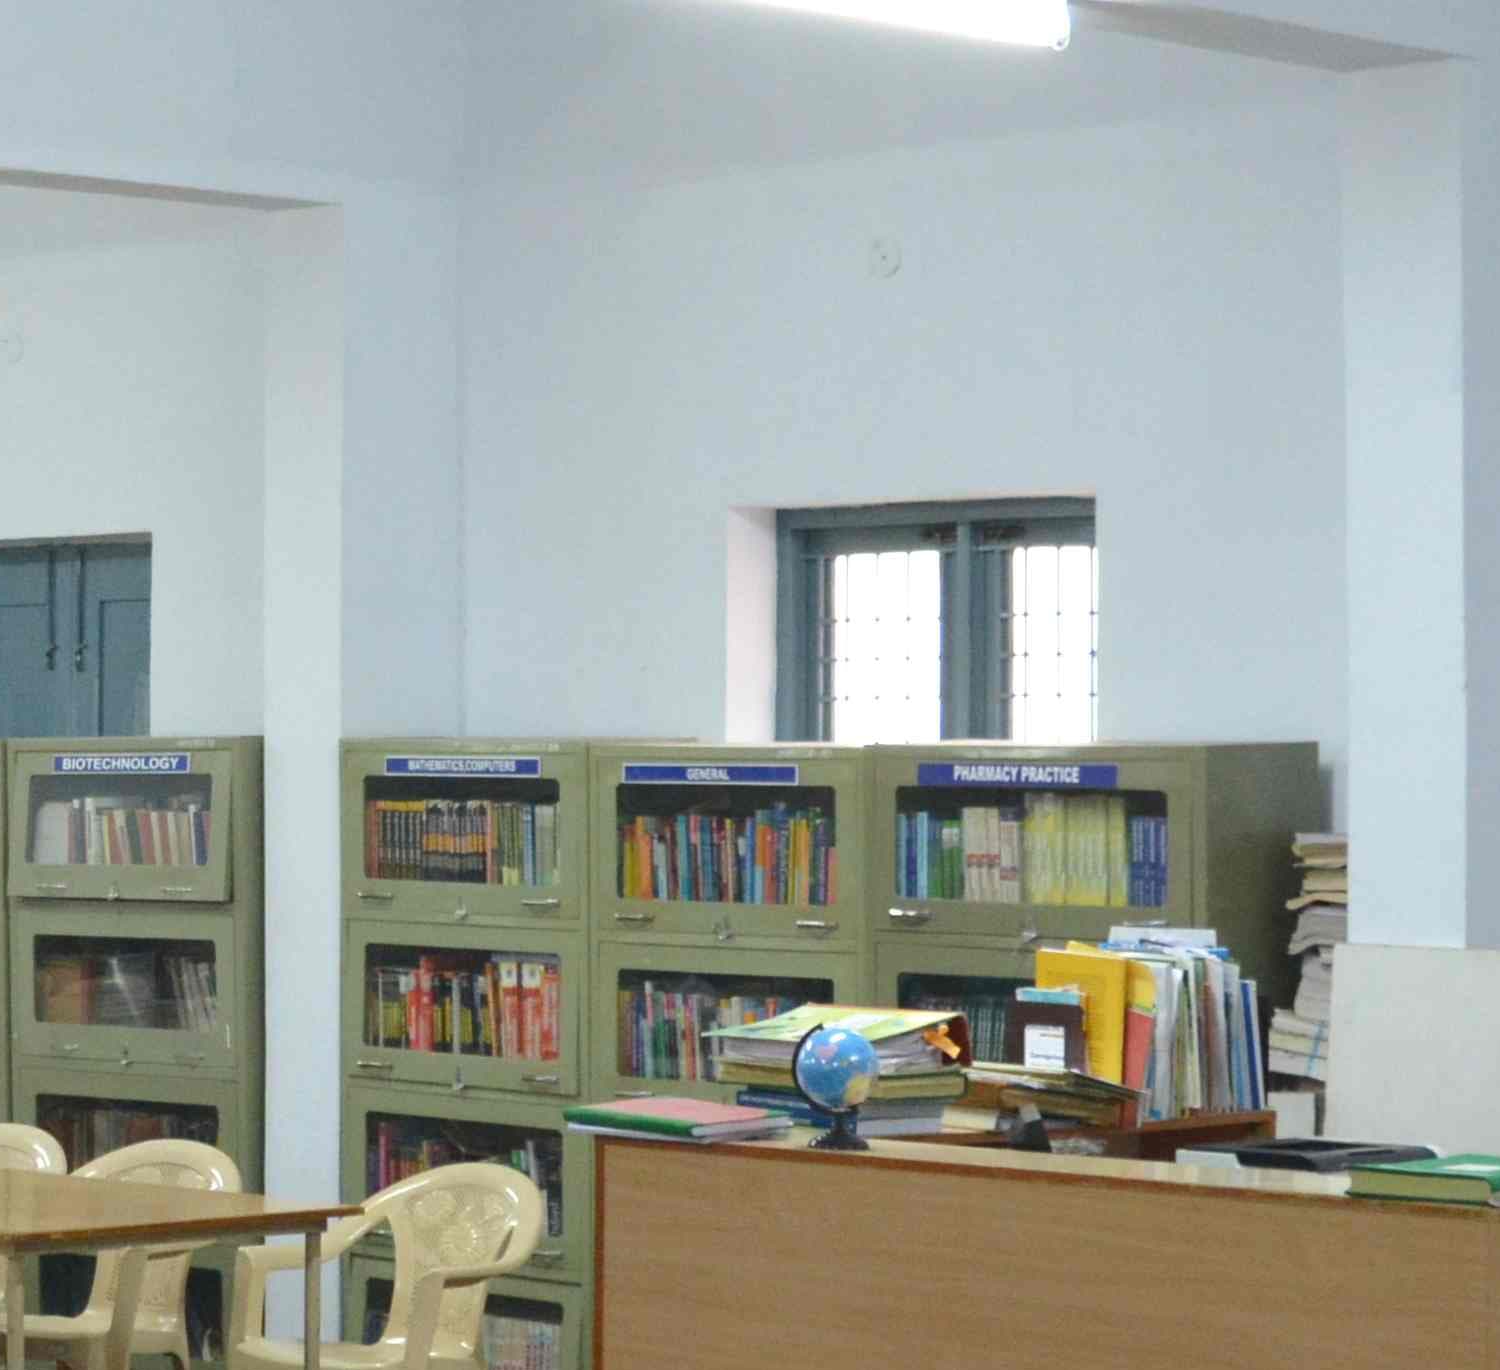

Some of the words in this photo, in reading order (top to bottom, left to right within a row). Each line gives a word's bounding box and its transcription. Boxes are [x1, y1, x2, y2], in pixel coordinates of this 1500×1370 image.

[61, 757, 180, 771] BIOTECHNOLOGY
[685, 767, 730, 781] GENERAL
[952, 764, 1019, 783] PHARMACY
[1021, 766, 1081, 784] PRACTICE
